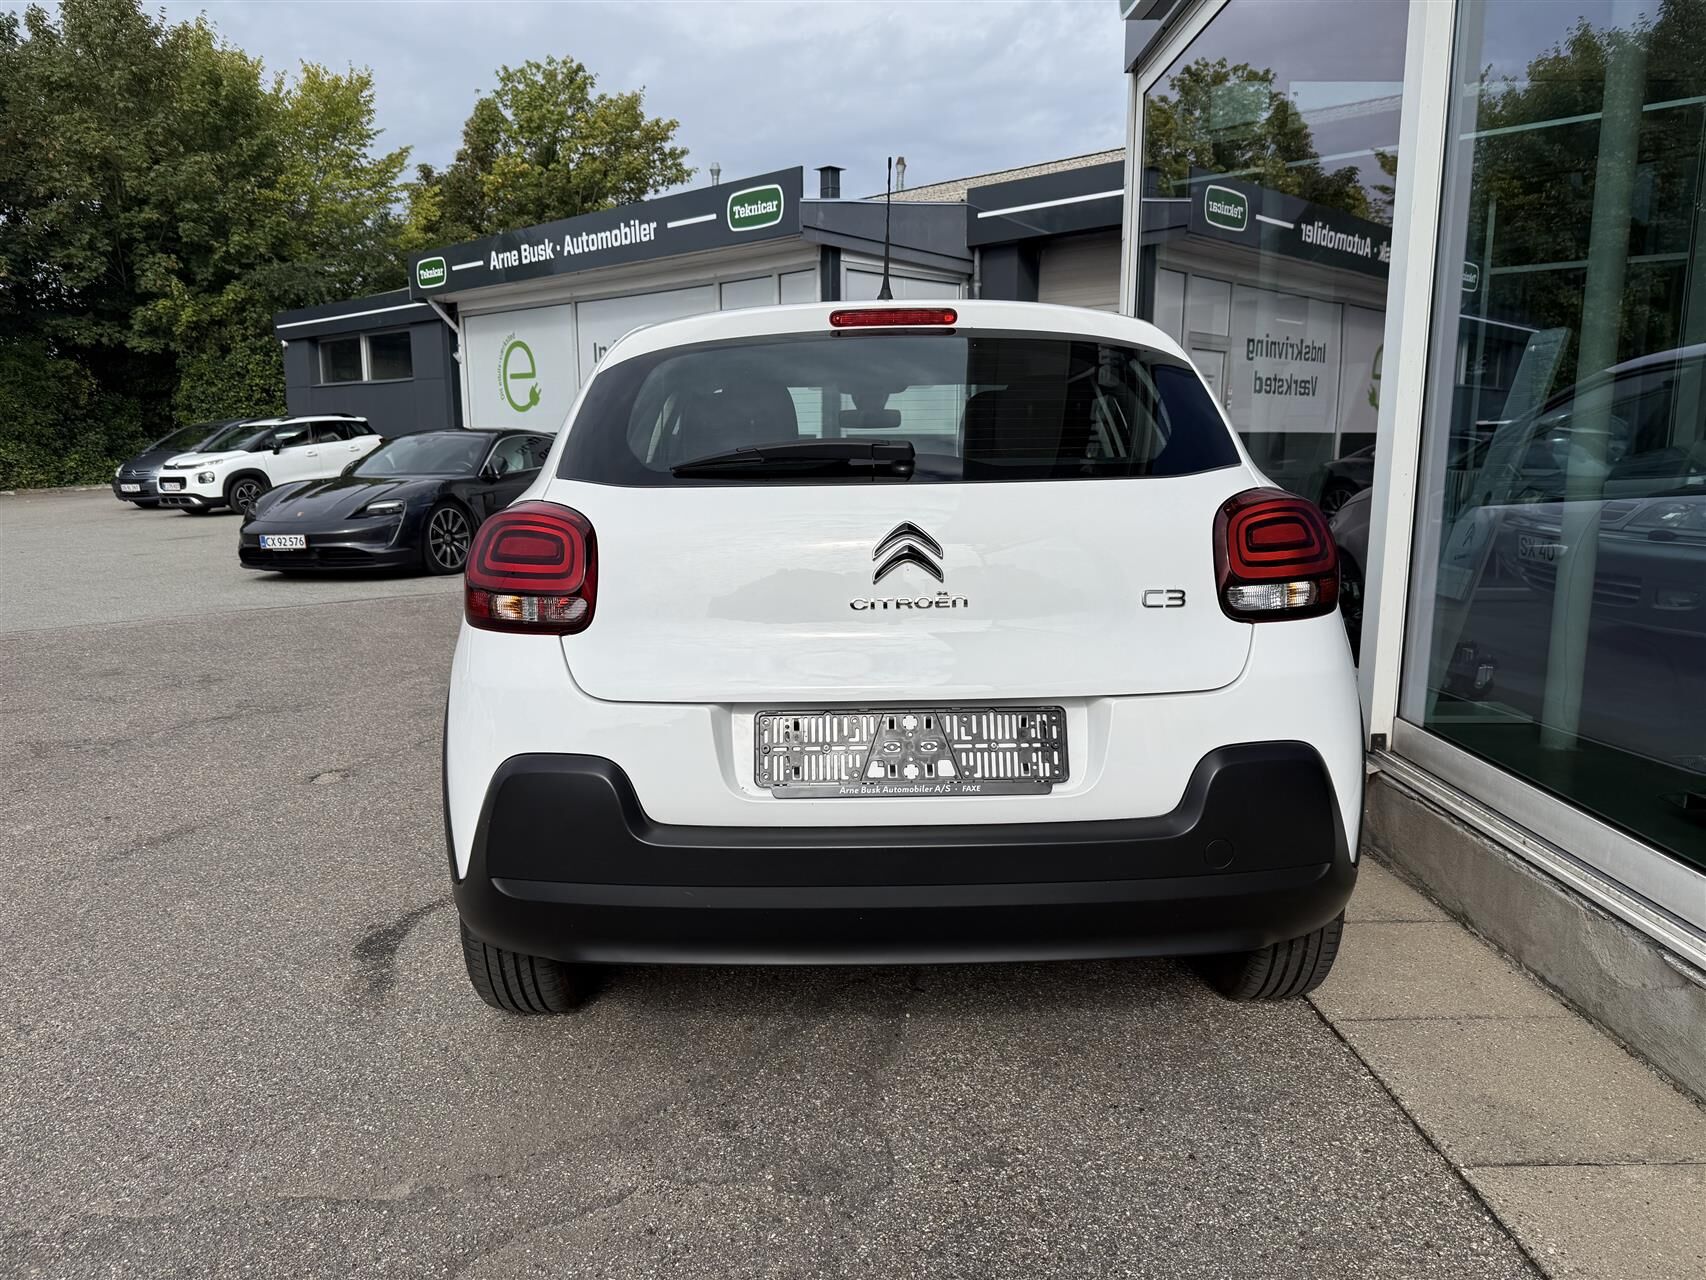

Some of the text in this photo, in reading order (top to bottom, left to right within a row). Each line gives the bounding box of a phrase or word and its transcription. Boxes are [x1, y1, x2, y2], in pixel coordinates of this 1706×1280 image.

[732, 198, 779, 220] Teknicar
[489, 219, 658, 271] Arne Busk Automobiler
[419, 264, 444, 281] Teknicar
[266, 536, 304, 547] CX 92 576
[1141, 589, 1186, 609] C3
[839, 784, 981, 795] Arne Busk Automobiler A/S FAXE
